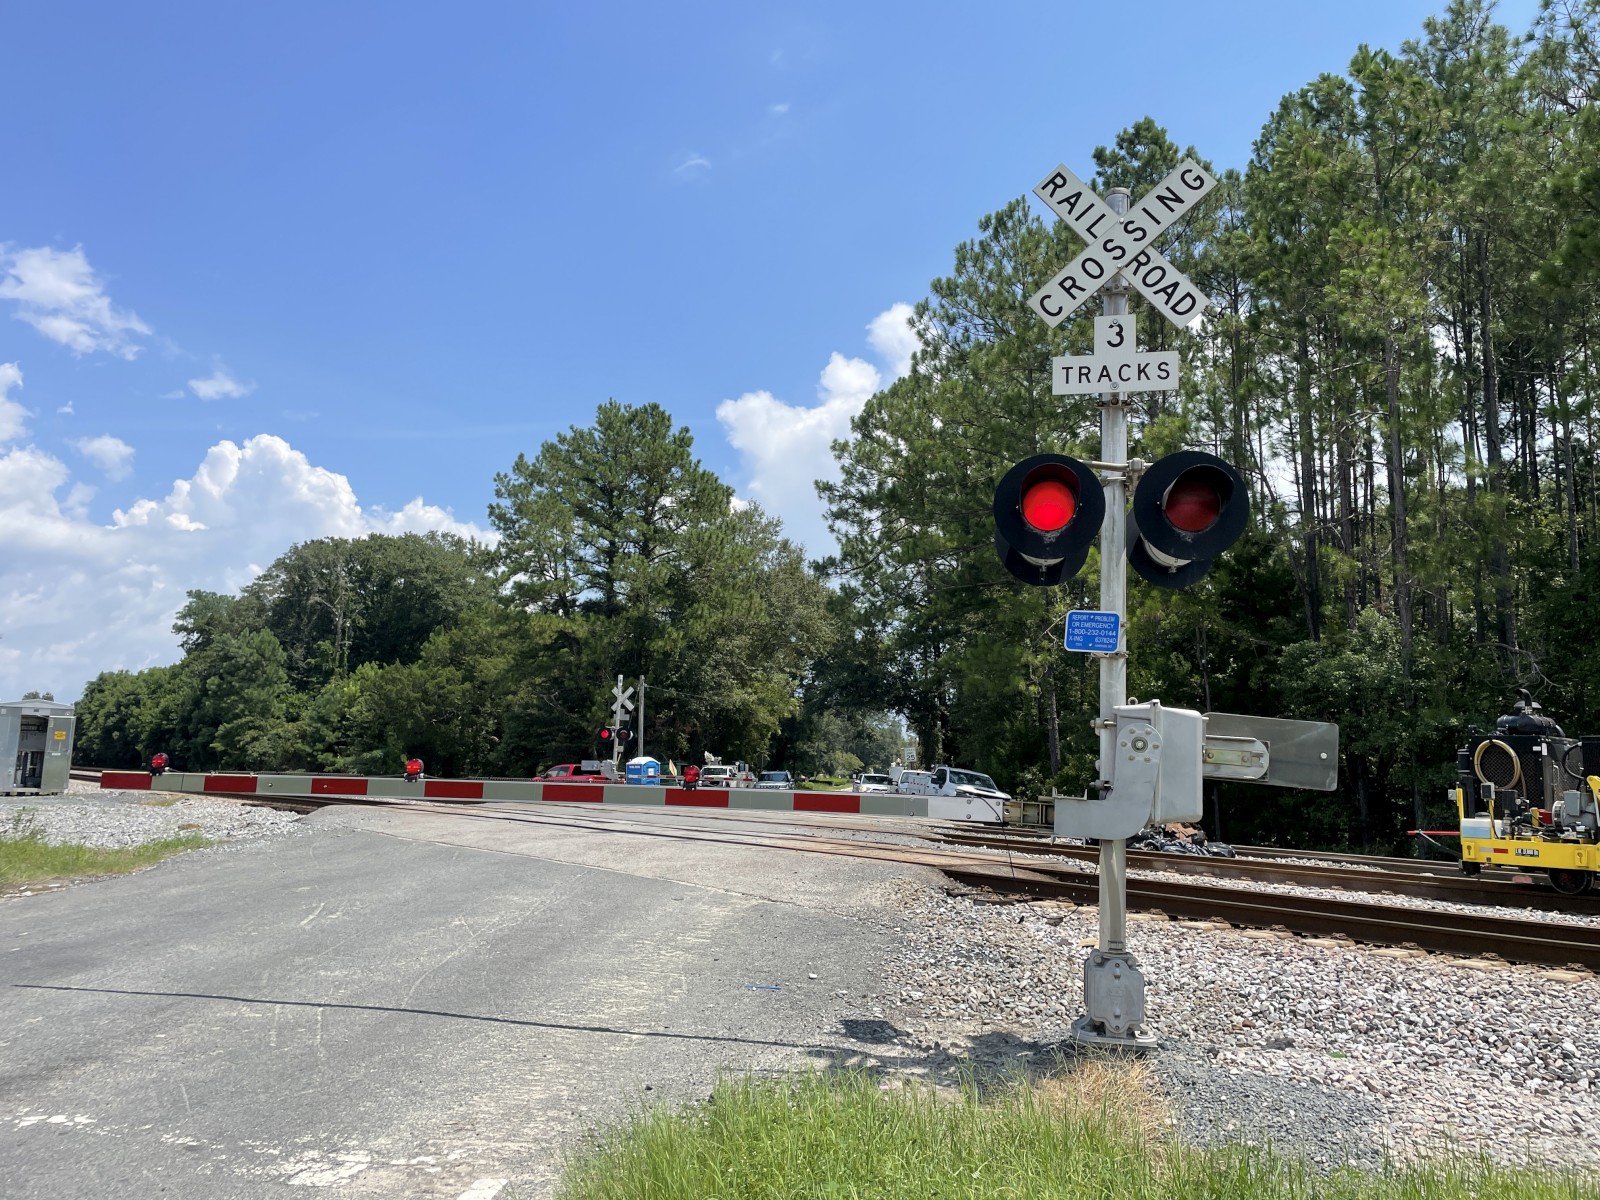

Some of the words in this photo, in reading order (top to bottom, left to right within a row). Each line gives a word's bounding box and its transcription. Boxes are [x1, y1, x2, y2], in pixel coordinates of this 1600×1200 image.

[1039, 168, 1205, 317] CROSSING
[1041, 171, 1107, 240] RAIL
[1125, 249, 1197, 316] ROAD
[1061, 361, 1171, 385] TRACKS
[1106, 322, 1125, 348] 3
